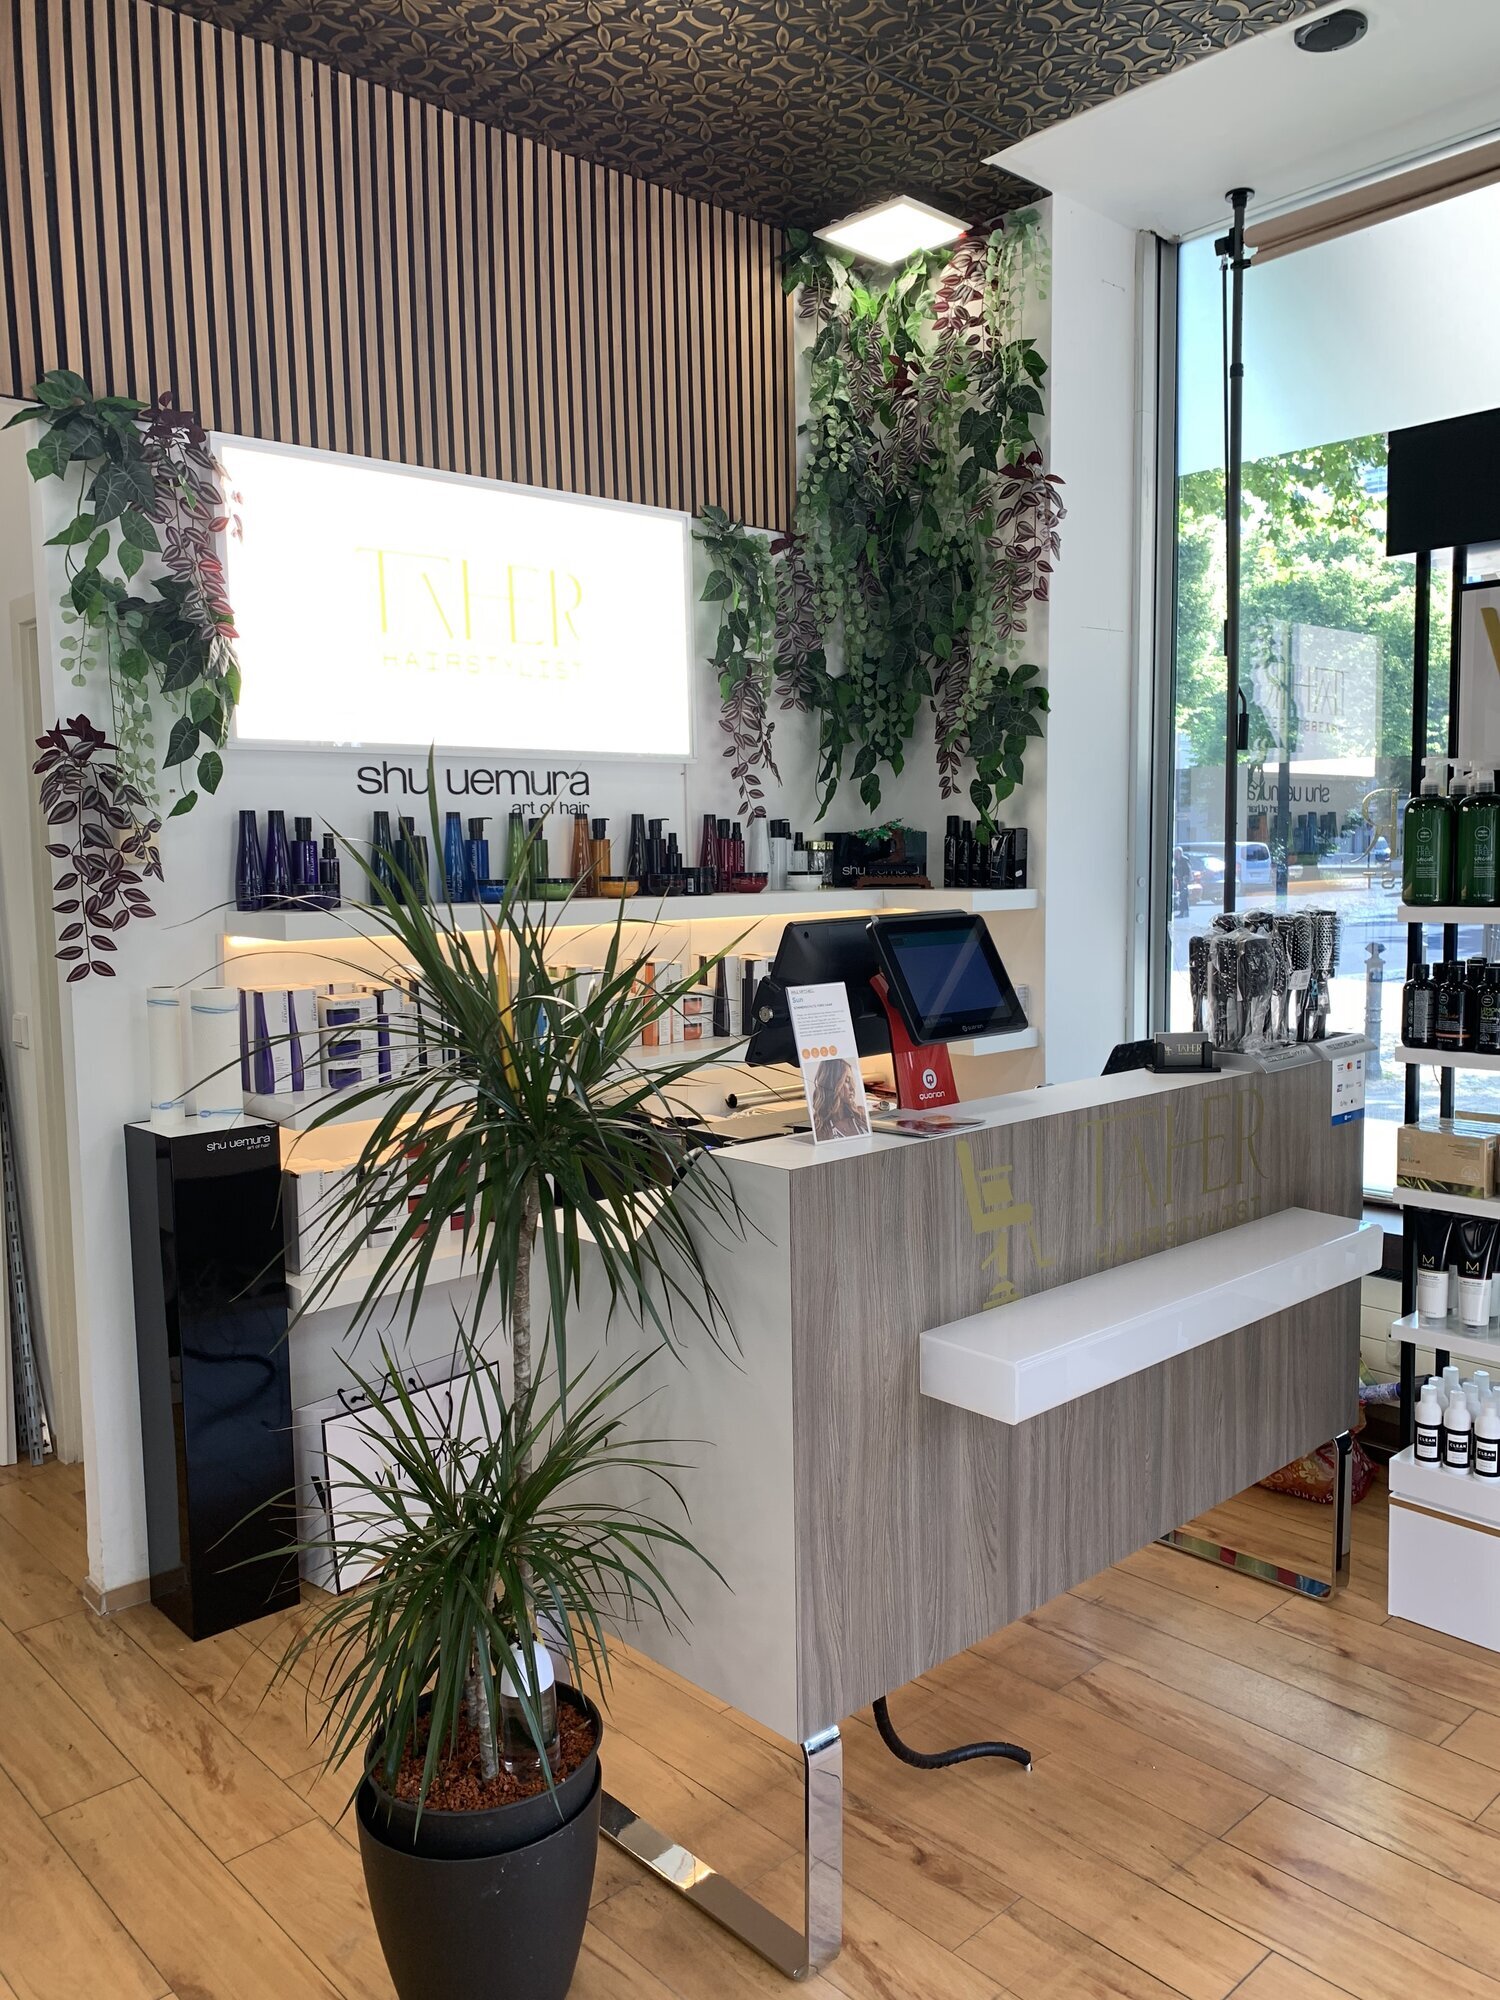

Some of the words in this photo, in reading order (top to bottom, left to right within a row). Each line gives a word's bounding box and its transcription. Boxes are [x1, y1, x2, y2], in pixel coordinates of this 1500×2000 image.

[357, 761, 430, 794] shu
[446, 769, 590, 796] uemura
[511, 802, 534, 815] art
[560, 802, 590, 815] hair
[842, 865, 866, 876] shu
[206, 1141, 227, 1152] shu
[229, 1134, 271, 1148] uemura
[1077, 1087, 1271, 1228] TAHER
